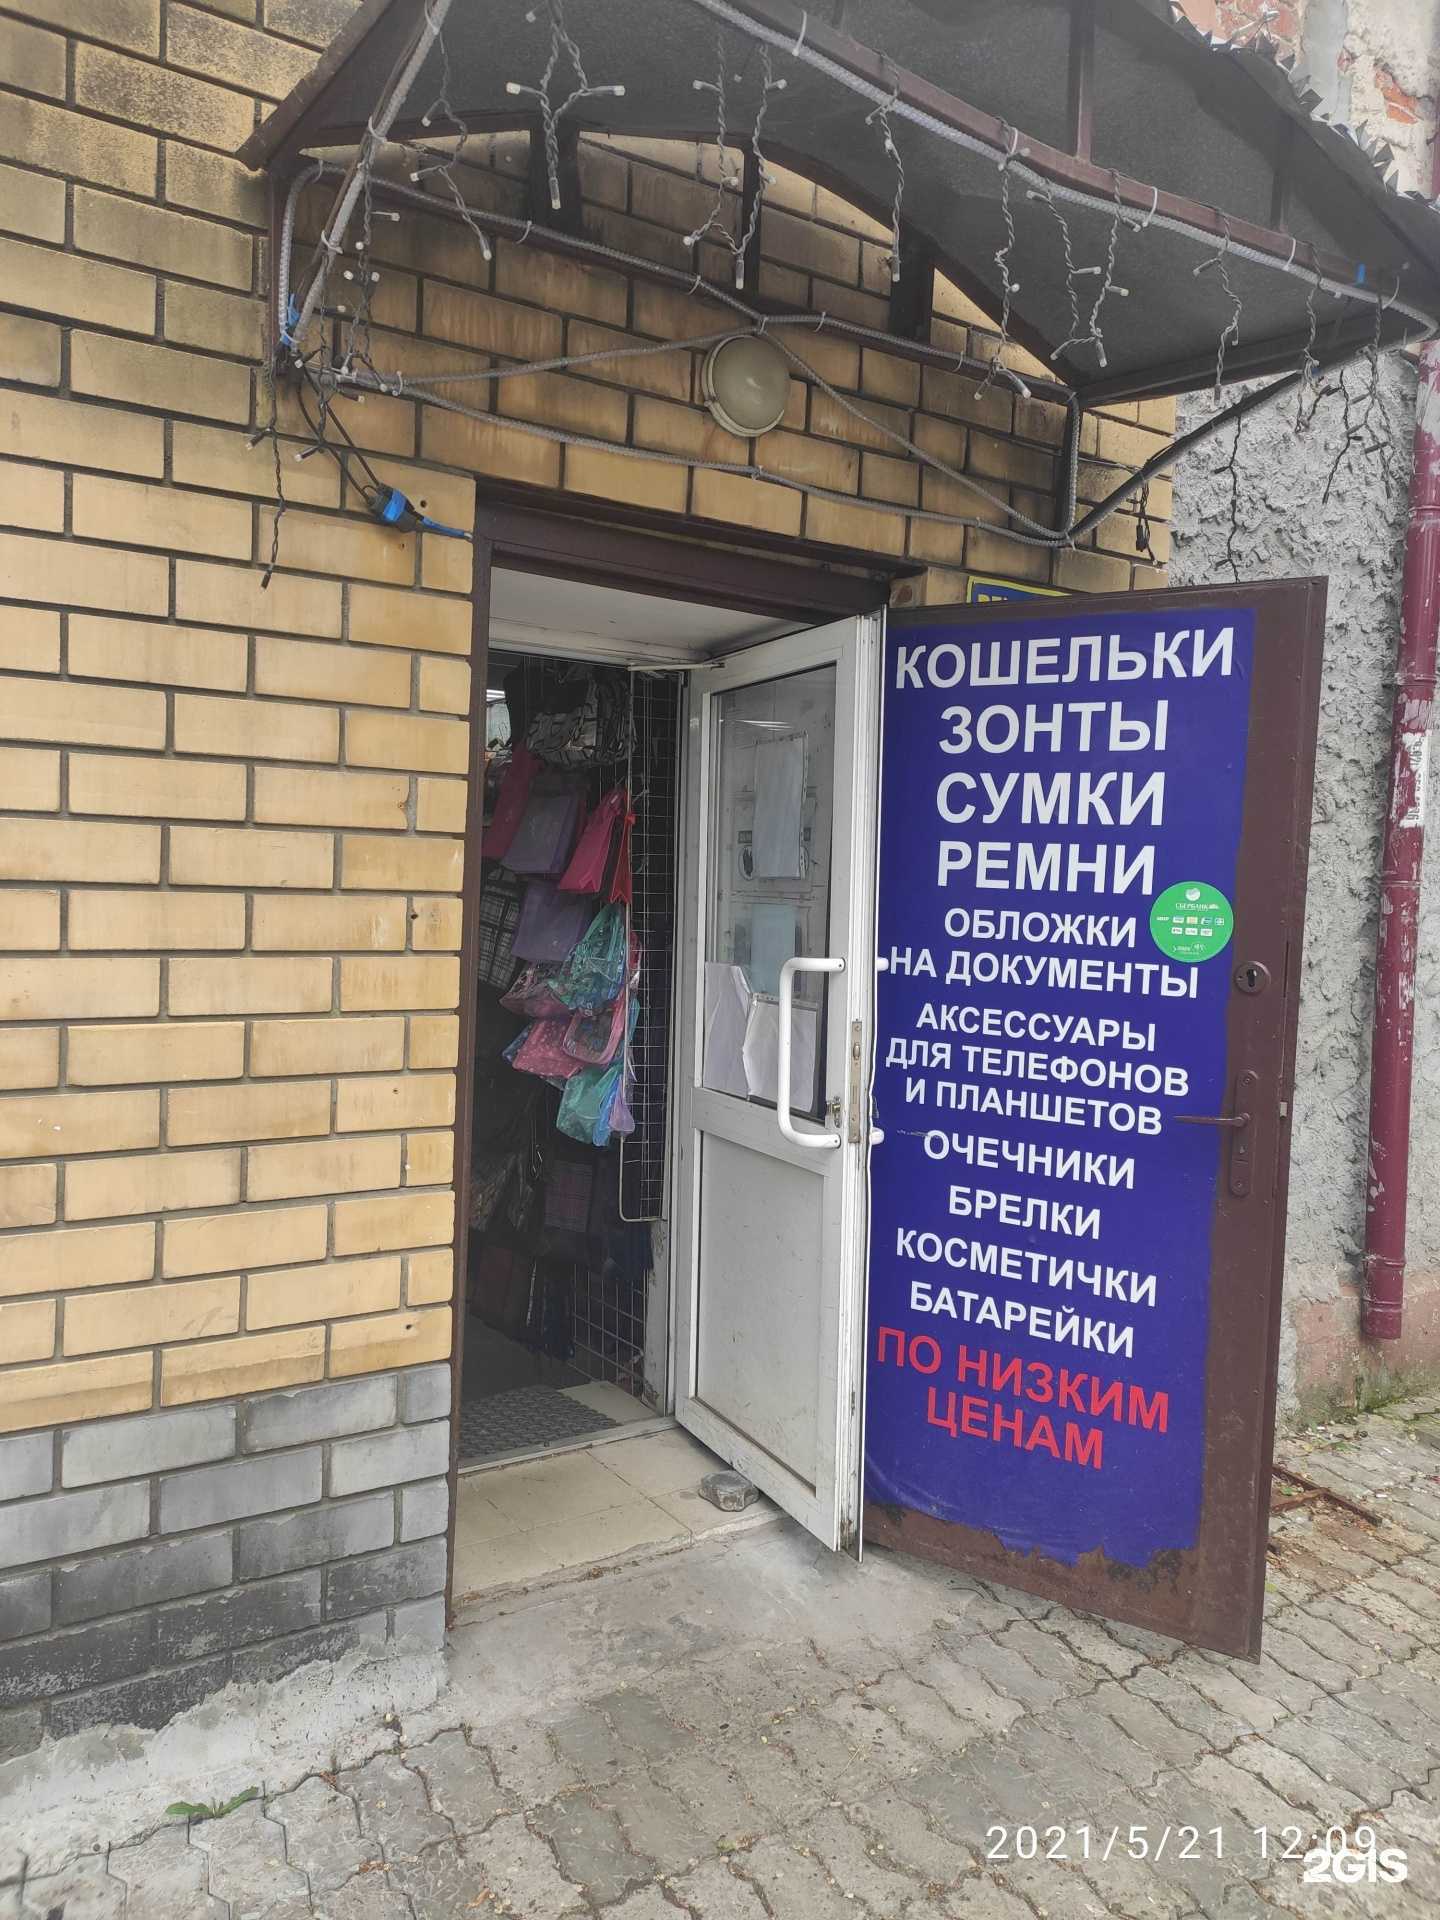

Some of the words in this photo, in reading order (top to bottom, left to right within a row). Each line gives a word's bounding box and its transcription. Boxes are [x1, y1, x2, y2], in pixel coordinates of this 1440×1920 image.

[895, 627, 1235, 688] КОШЕЛЬКИ
[938, 700, 1169, 754] ЗОНТЫ
[936, 771, 1166, 826] СУМКИ
[937, 840, 1156, 895] РЕМНИ
[944, 907, 1137, 948] ОБЛОЖКИ
[890, 946, 937, 978] НА
[945, 951, 1198, 998] ДОКУМЕНТЫ
[916, 1003, 1156, 1052] АКСЕССУАРЫ
[885, 1037, 952, 1070] ДЛЯ
[961, 1045, 1189, 1097] ТЕЛЕФОНОВ
[905, 1077, 926, 1105] И
[936, 1081, 1162, 1136] ПЛАНШЕТОВ
[924, 1130, 1135, 1190] ОЧЕЧНИКИ
[949, 1185, 1101, 1240] БРЕЛКИ
[896, 1227, 1157, 1307] КОСМЕТИЧКИ
[910, 1280, 1135, 1358] БАТАРЕЙКИ
[877, 1326, 942, 1374] ПО
[957, 1345, 1169, 1432] НИЗКИМ
[927, 1386, 1103, 1470] ЦЕНАМ
